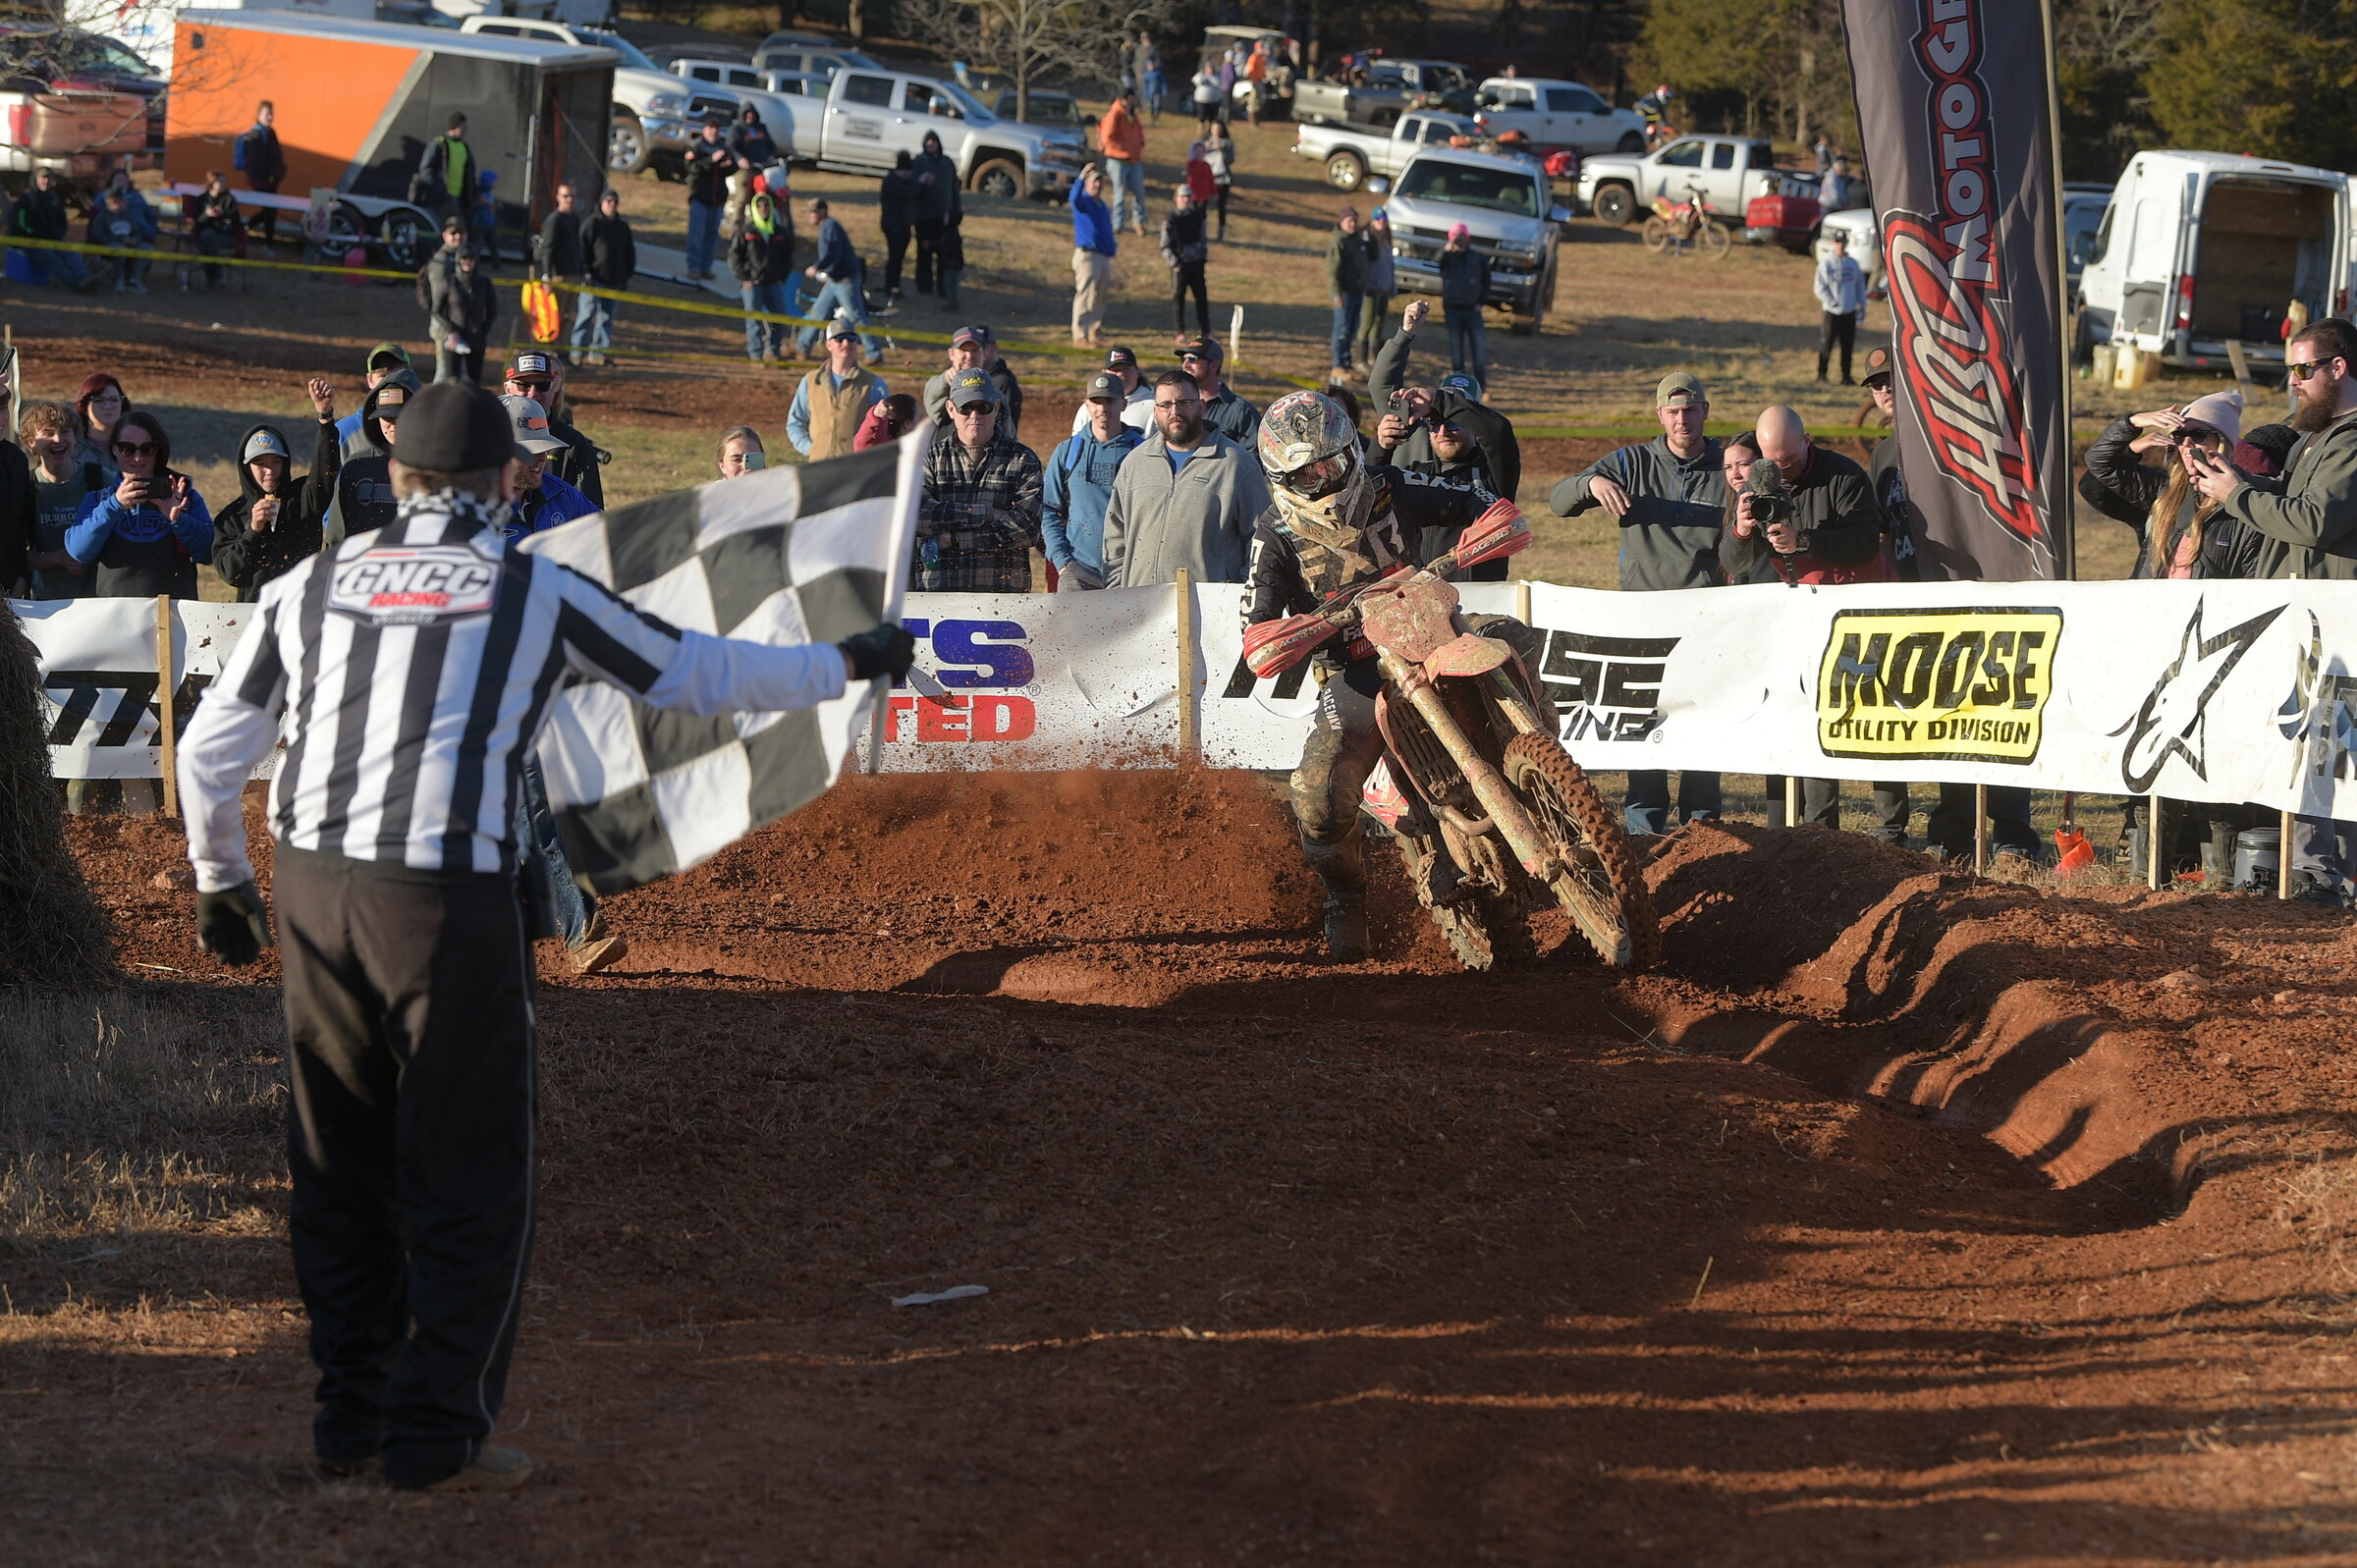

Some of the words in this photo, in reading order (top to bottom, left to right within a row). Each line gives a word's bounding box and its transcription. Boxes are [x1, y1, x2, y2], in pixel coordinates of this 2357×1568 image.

[522, 358, 543, 367] FUEL
[338, 562, 490, 597] GNCC
[367, 592, 453, 607] RACING
[1829, 631, 2047, 710] MOOSE
[1927, 719, 2031, 744] DIVISION
